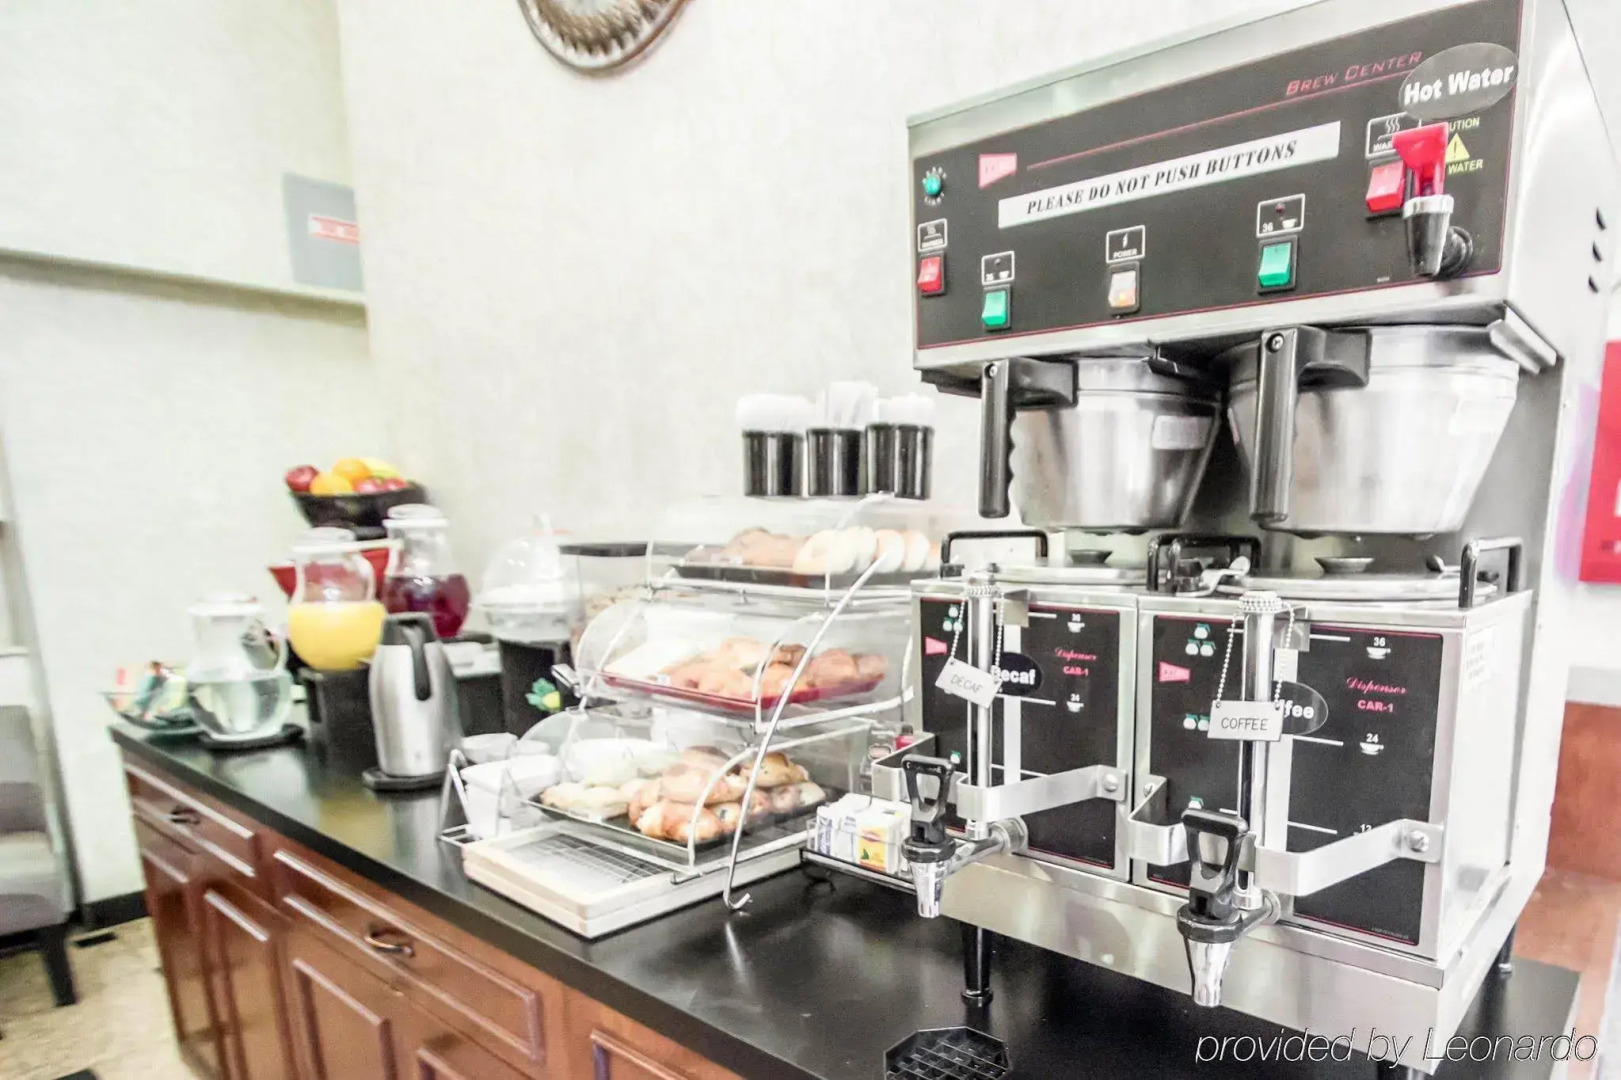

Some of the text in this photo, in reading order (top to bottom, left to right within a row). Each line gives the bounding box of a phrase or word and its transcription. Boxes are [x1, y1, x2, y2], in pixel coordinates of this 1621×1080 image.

[1286, 52, 1423, 96] BREW CENTER
[1403, 65, 1514, 106] Hot Water
[1449, 117, 1480, 132] UTION
[1448, 158, 1484, 175] WATER
[1026, 140, 1298, 214] PLEASE DO NOT PUSH BUTTONS
[1113, 248, 1138, 259] POWER
[1373, 637, 1386, 647] 36
[991, 664, 1036, 686] Decaf
[1062, 665, 1089, 677] CAR-1
[950, 673, 984, 693] DECAF
[1346, 676, 1407, 695] Dispenser
[1357, 699, 1394, 713] CAR-1
[1221, 716, 1269, 732] COFFEE
[1366, 733, 1379, 743] 24
